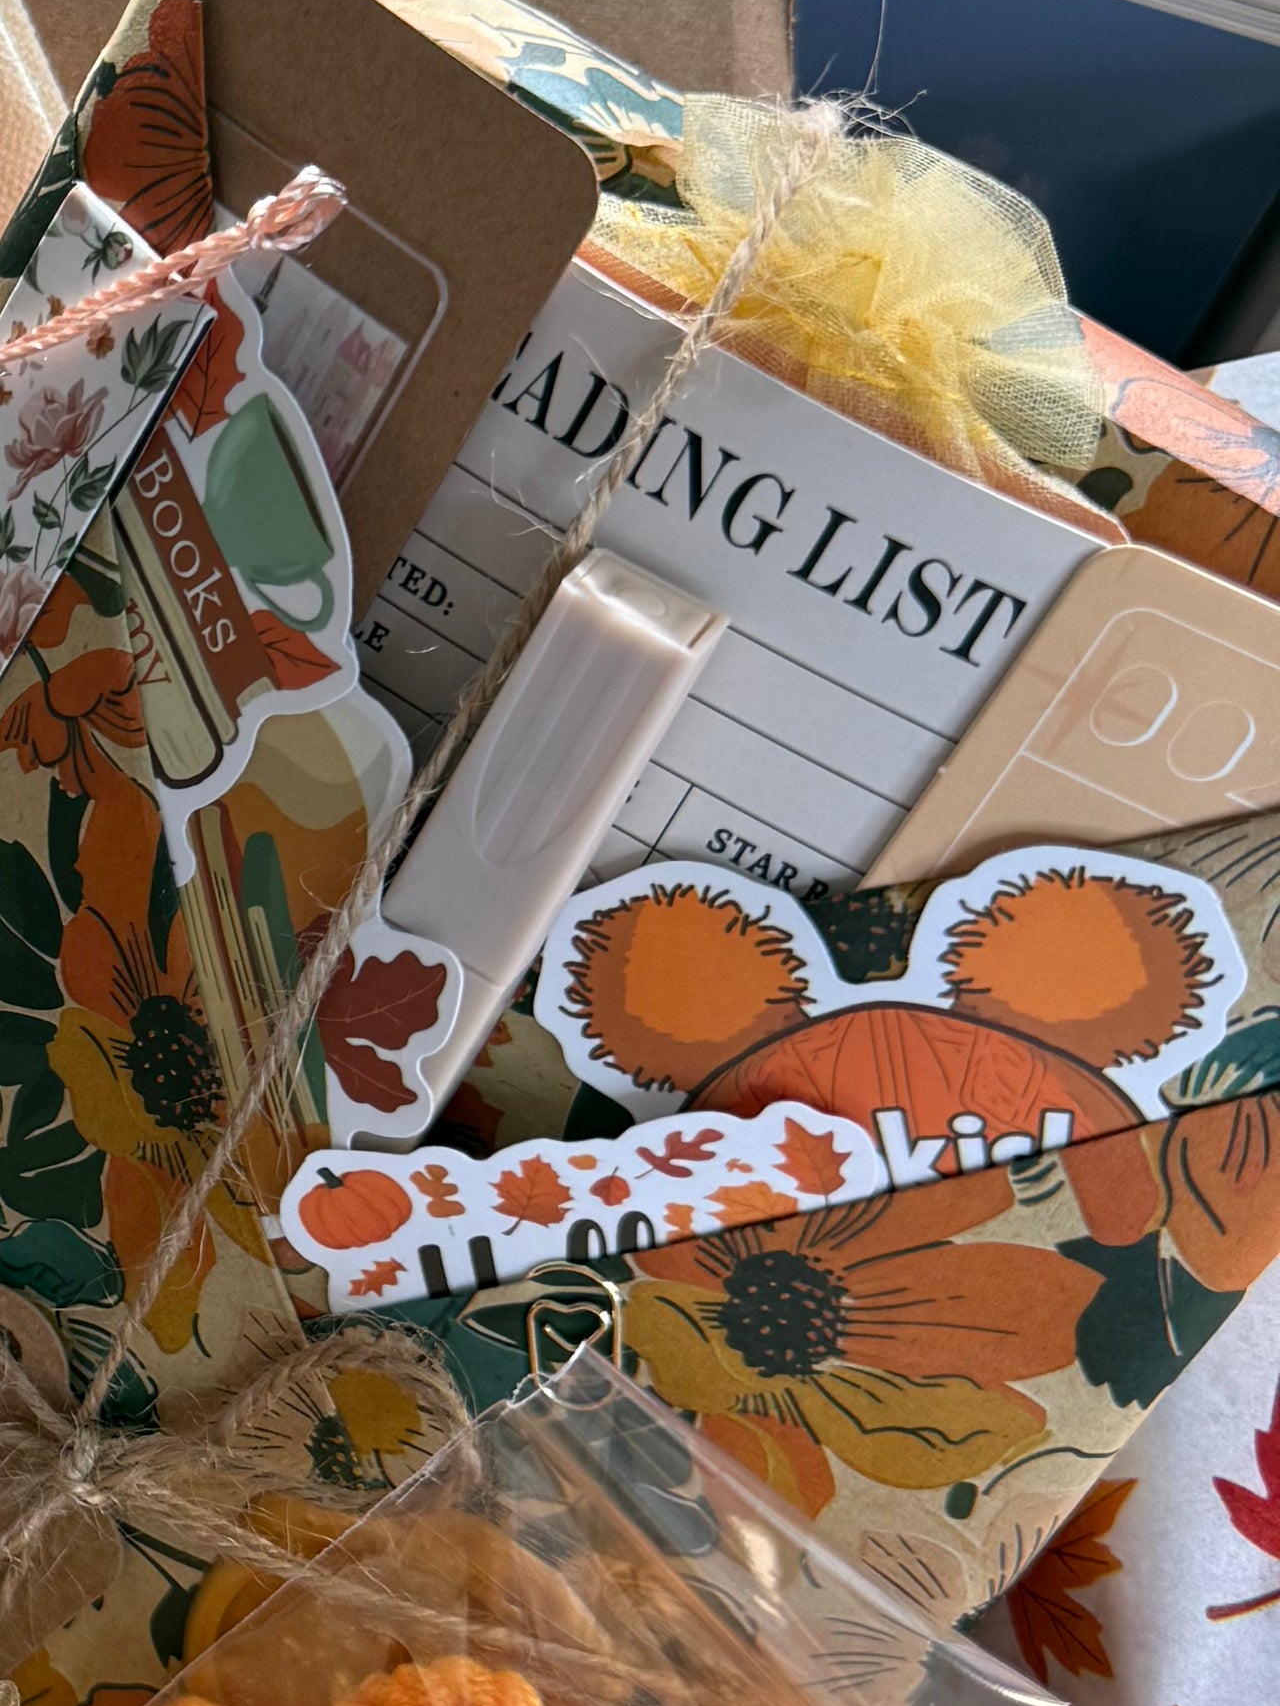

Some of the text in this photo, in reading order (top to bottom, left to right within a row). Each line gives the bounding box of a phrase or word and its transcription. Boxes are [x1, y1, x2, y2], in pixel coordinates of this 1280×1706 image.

[133, 449, 237, 653] Books
[491, 332, 1028, 668] ADING LIST
[125, 597, 172, 686] my
[706, 828, 799, 892] STAR
